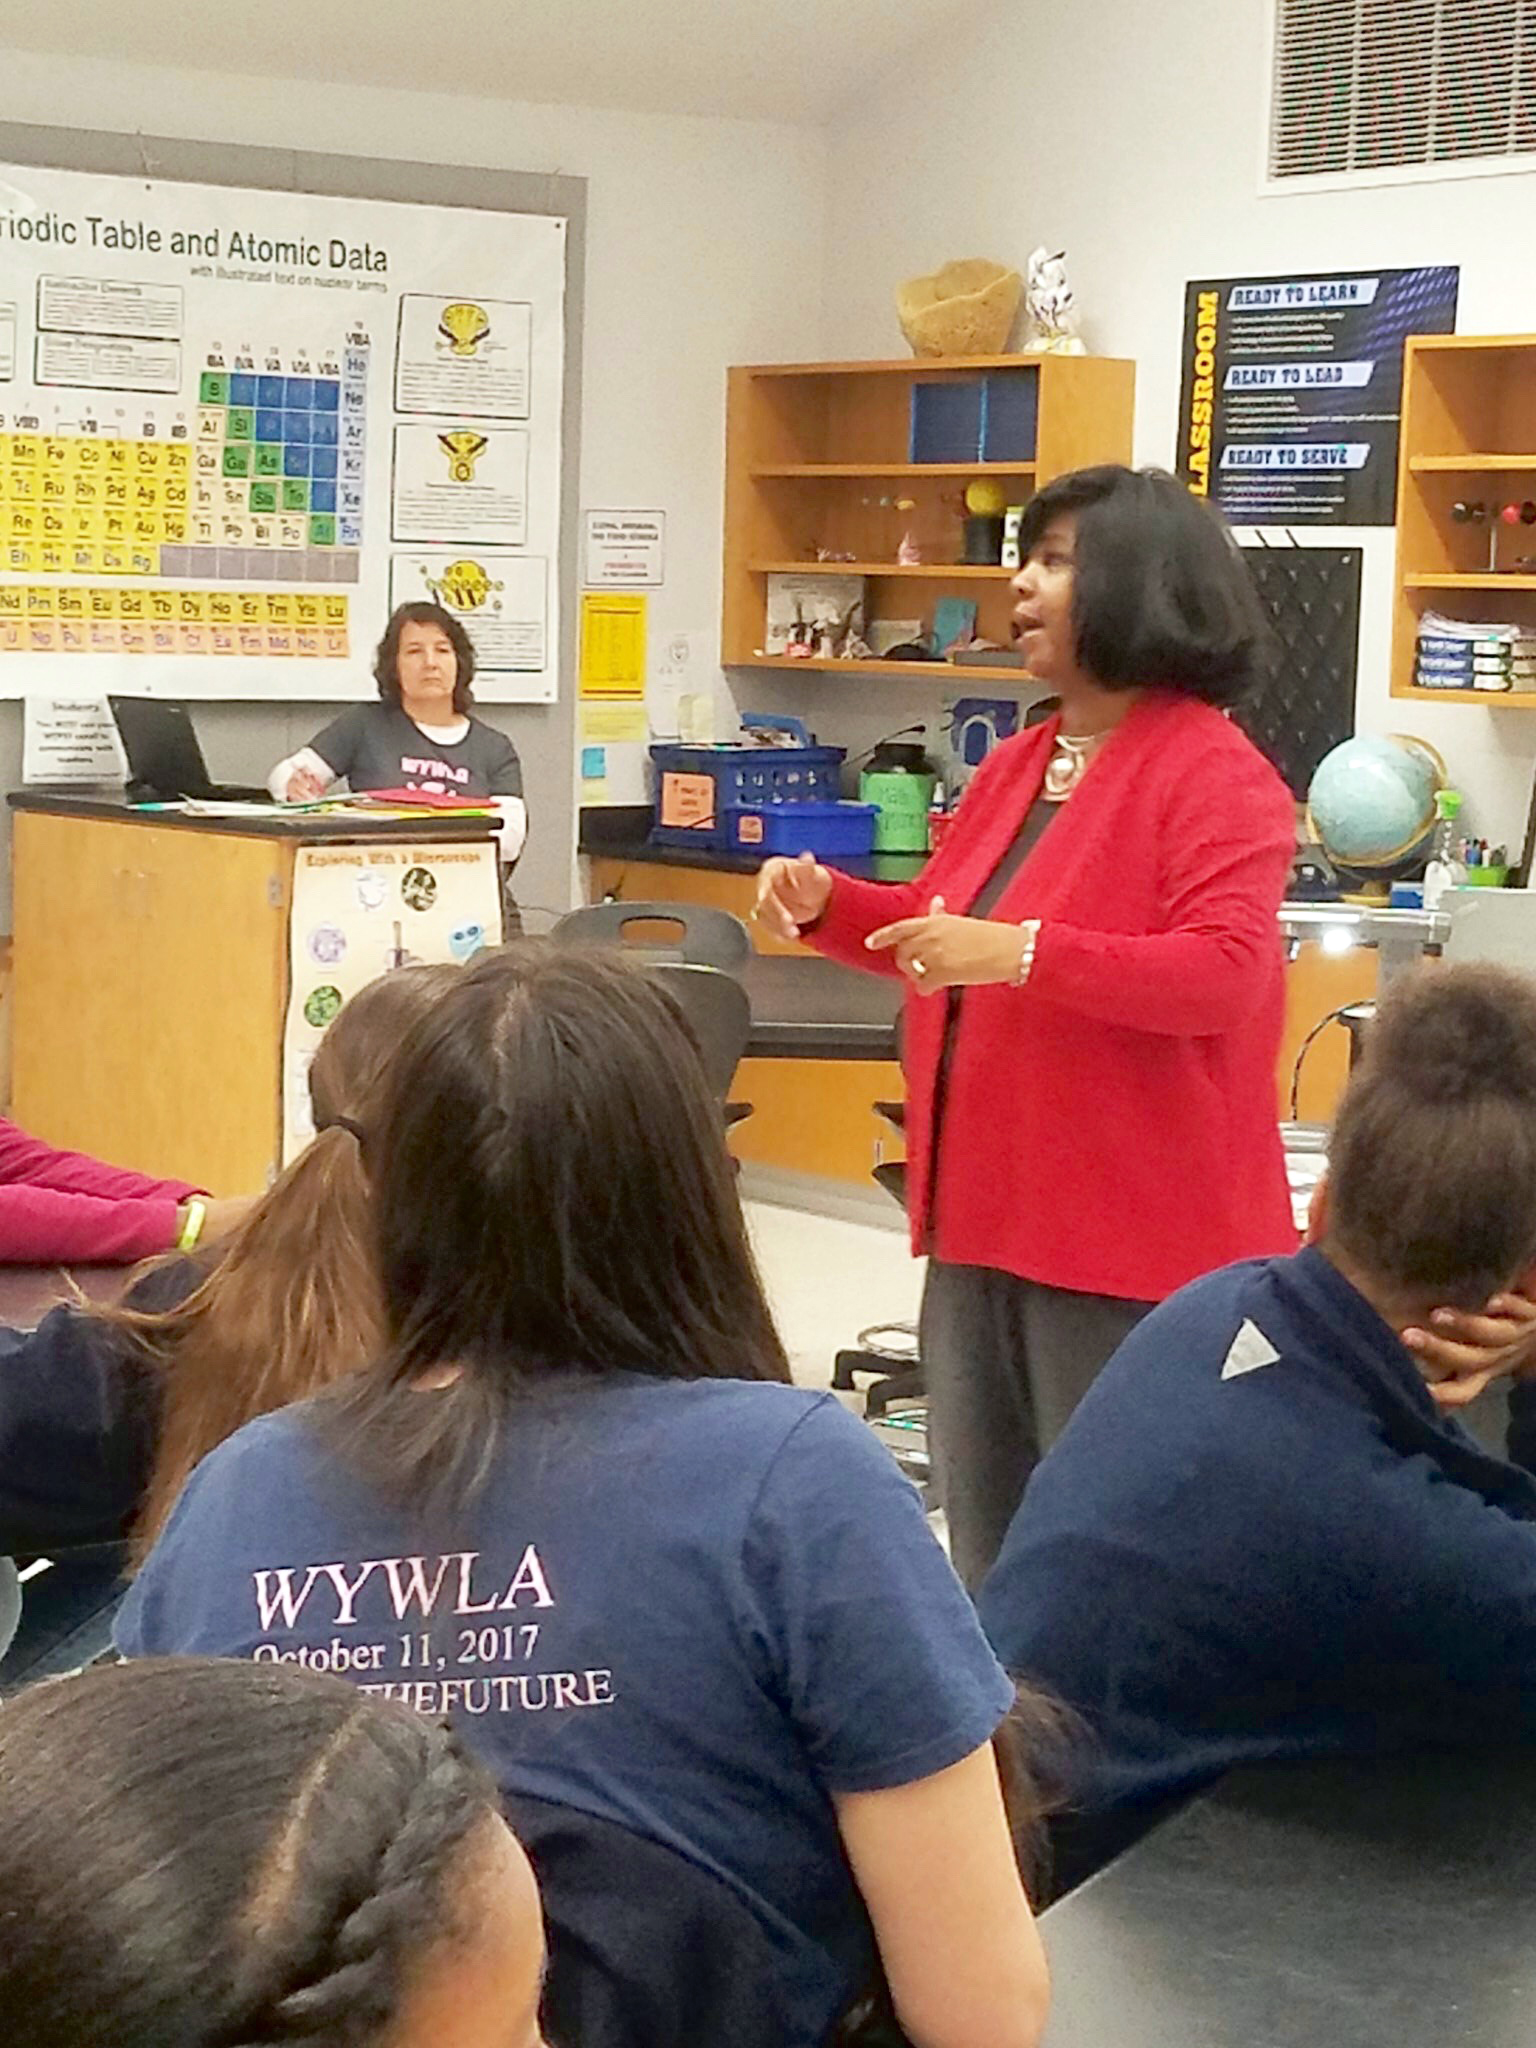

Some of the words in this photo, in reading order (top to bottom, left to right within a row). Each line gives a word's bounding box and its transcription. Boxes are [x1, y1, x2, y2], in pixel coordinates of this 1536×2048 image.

[86, 217, 162, 252] Table
[171, 229, 220, 257] and
[228, 231, 321, 267] Atomic
[329, 239, 388, 273] Data
[1234, 288, 1281, 305] READY
[1286, 287, 1304, 302] TO
[1309, 284, 1358, 301] LEARN
[1188, 291, 1219, 496] LASSROOM
[1231, 369, 1277, 385] READY
[1282, 369, 1300, 383] TO
[1305, 367, 1343, 383] LEAD
[1228, 449, 1272, 464] READY
[1278, 449, 1296, 464] TO
[1302, 448, 1348, 464] SERVE
[253, 1543, 555, 1632] WYWLA
[253, 1637, 387, 1672] October
[400, 1632, 447, 1673] 11,
[458, 1624, 540, 1665] 2017
[356, 1669, 618, 1715] HEFUTURE
